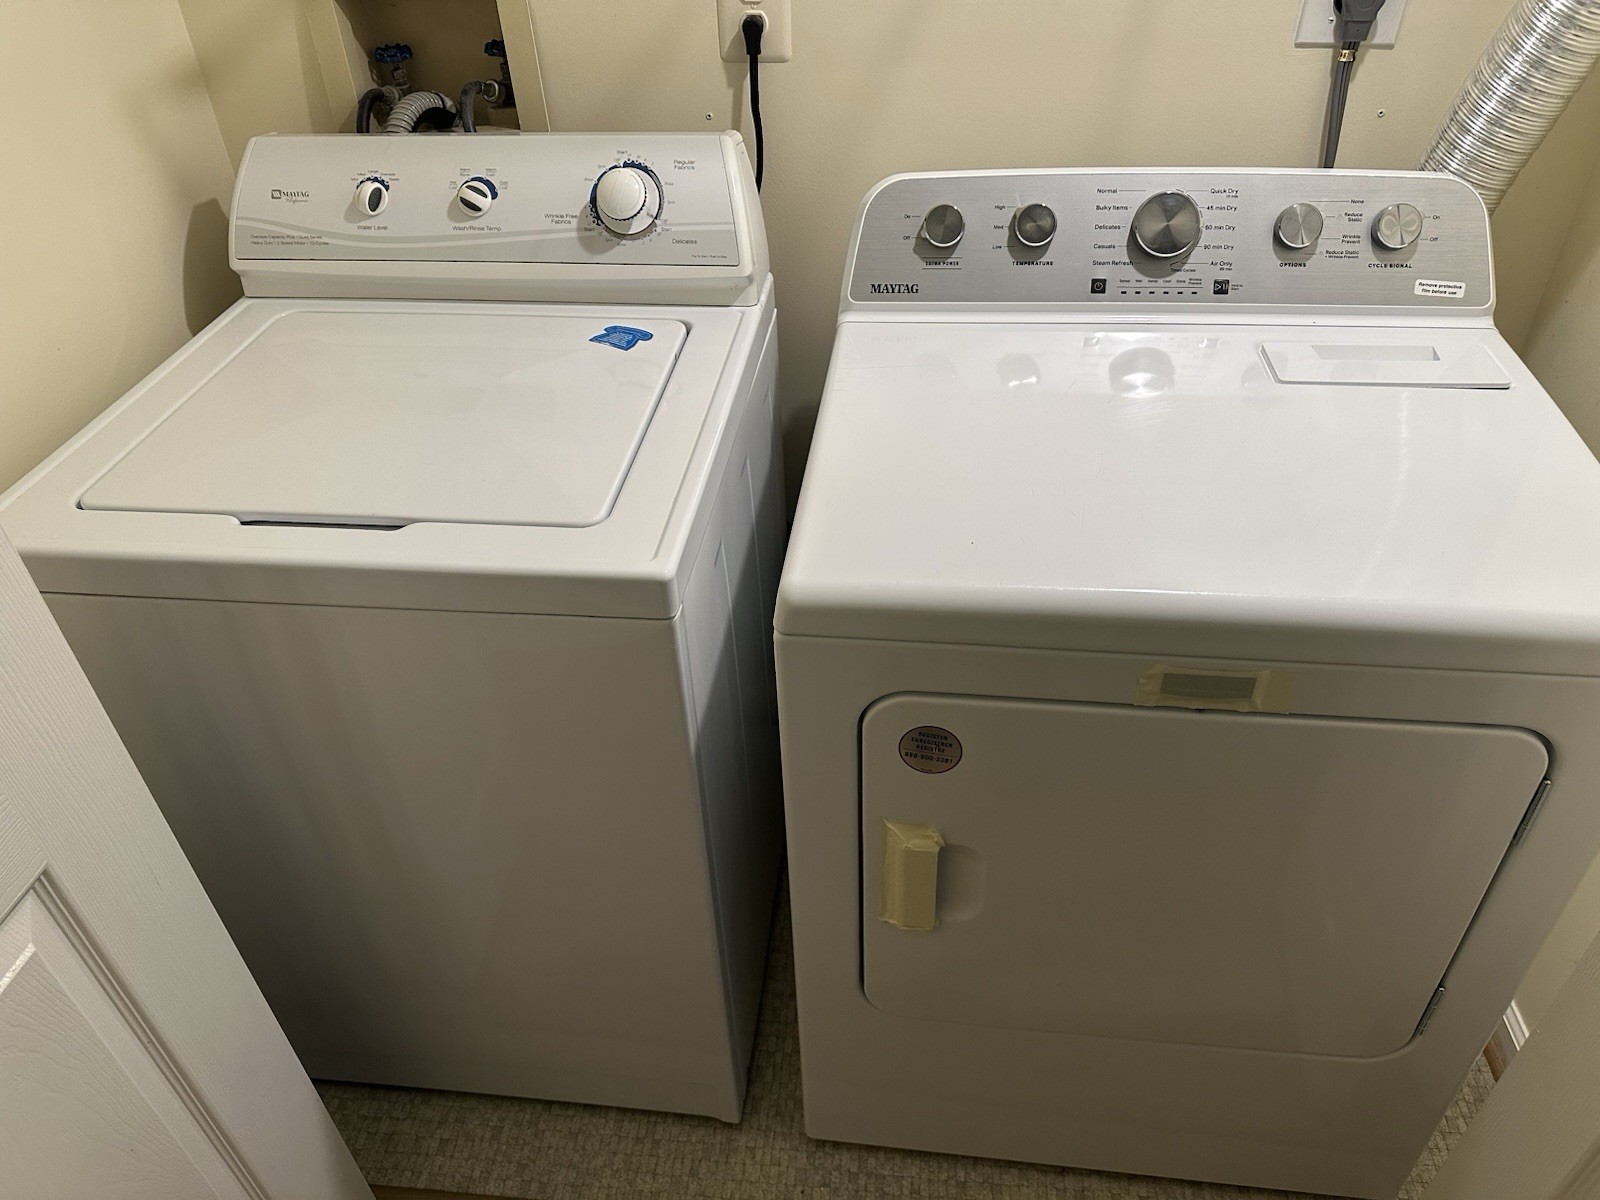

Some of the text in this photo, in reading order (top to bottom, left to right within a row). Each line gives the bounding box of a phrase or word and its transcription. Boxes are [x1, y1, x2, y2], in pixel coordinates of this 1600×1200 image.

[282, 190, 310, 198] MAYTAG
[994, 203, 1006, 211] High
[1095, 204, 1111, 212] Bulky
[1226, 204, 1238, 212] Dry
[1224, 224, 1236, 232] Dry
[870, 283, 920, 294] MAYTAG
